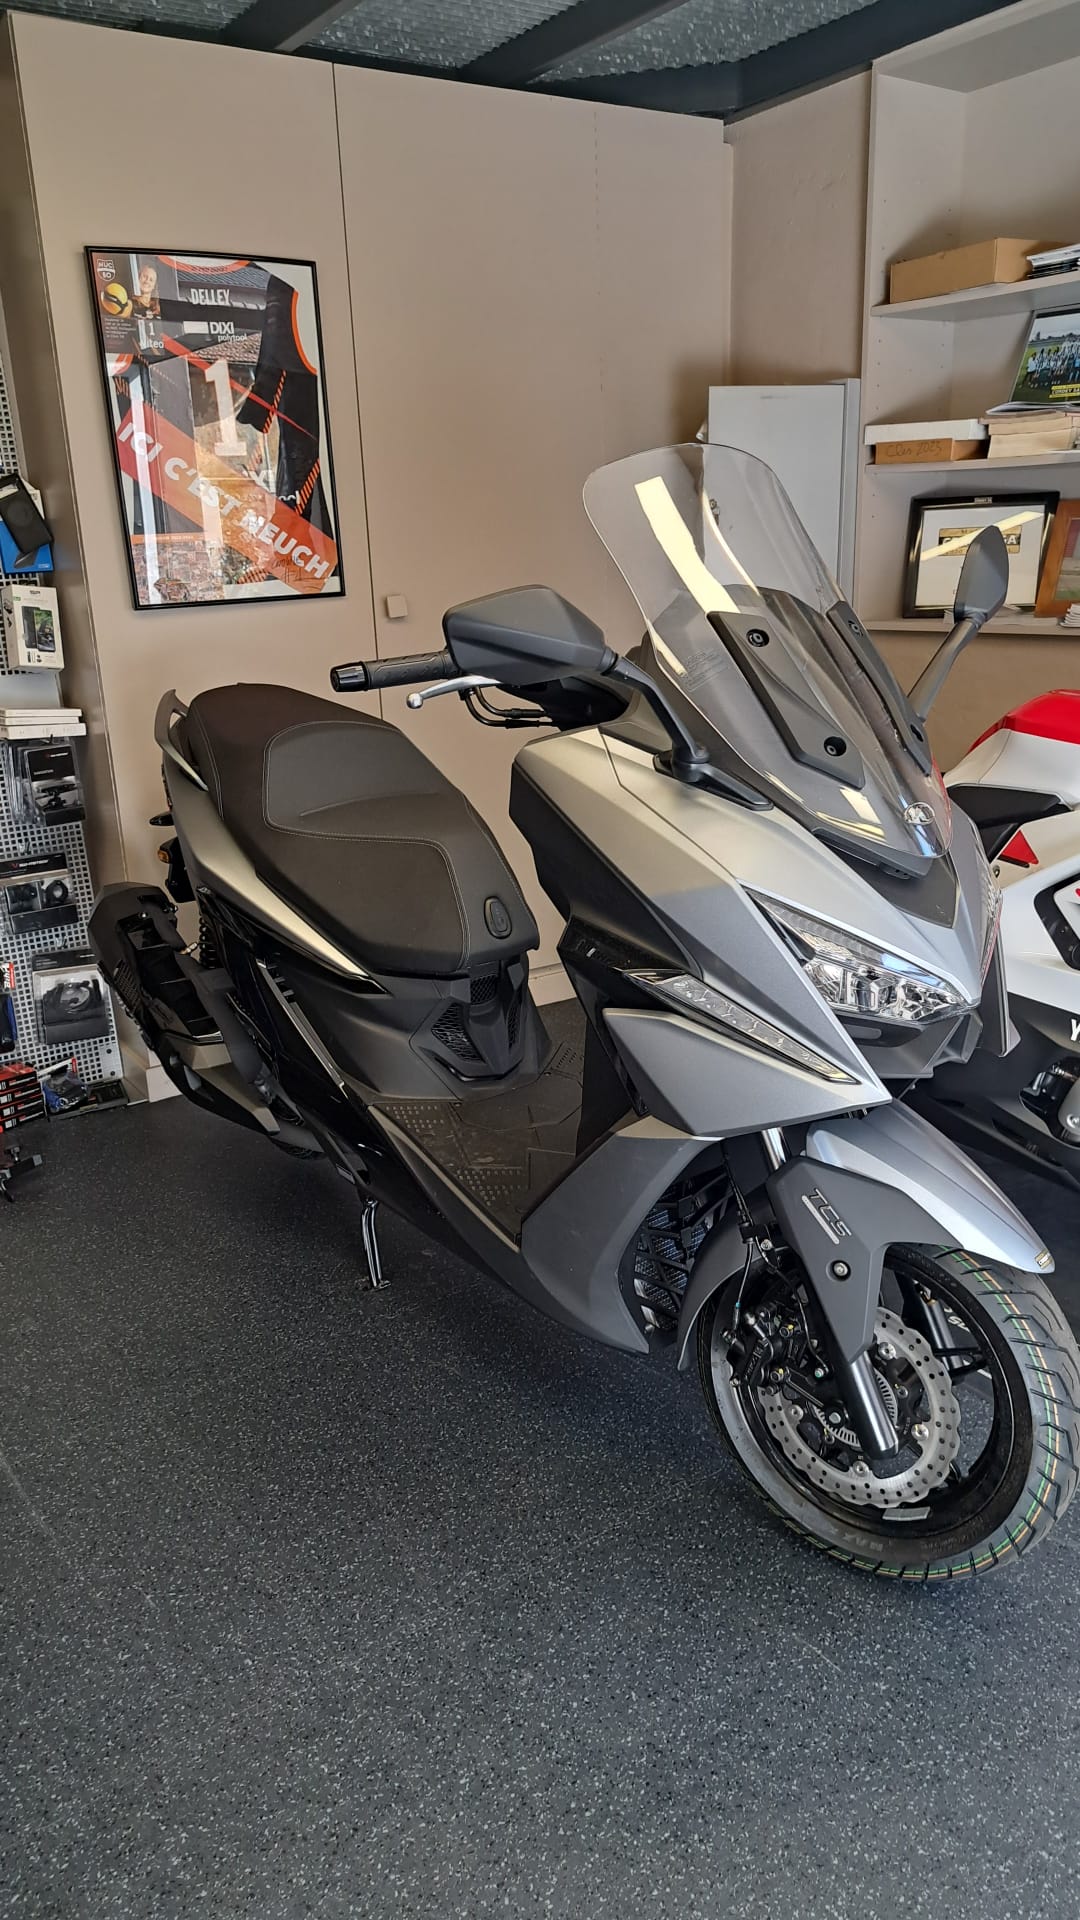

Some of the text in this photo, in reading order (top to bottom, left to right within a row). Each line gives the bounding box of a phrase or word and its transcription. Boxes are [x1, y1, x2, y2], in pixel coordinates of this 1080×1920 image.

[191, 288, 230, 306] DELLEY
[209, 322, 235, 335] DIXI
[205, 359, 247, 456] 1
[118, 422, 163, 463] ICI
[239, 509, 330, 578] NEUCH
[809, 1188, 852, 1236] TCS
